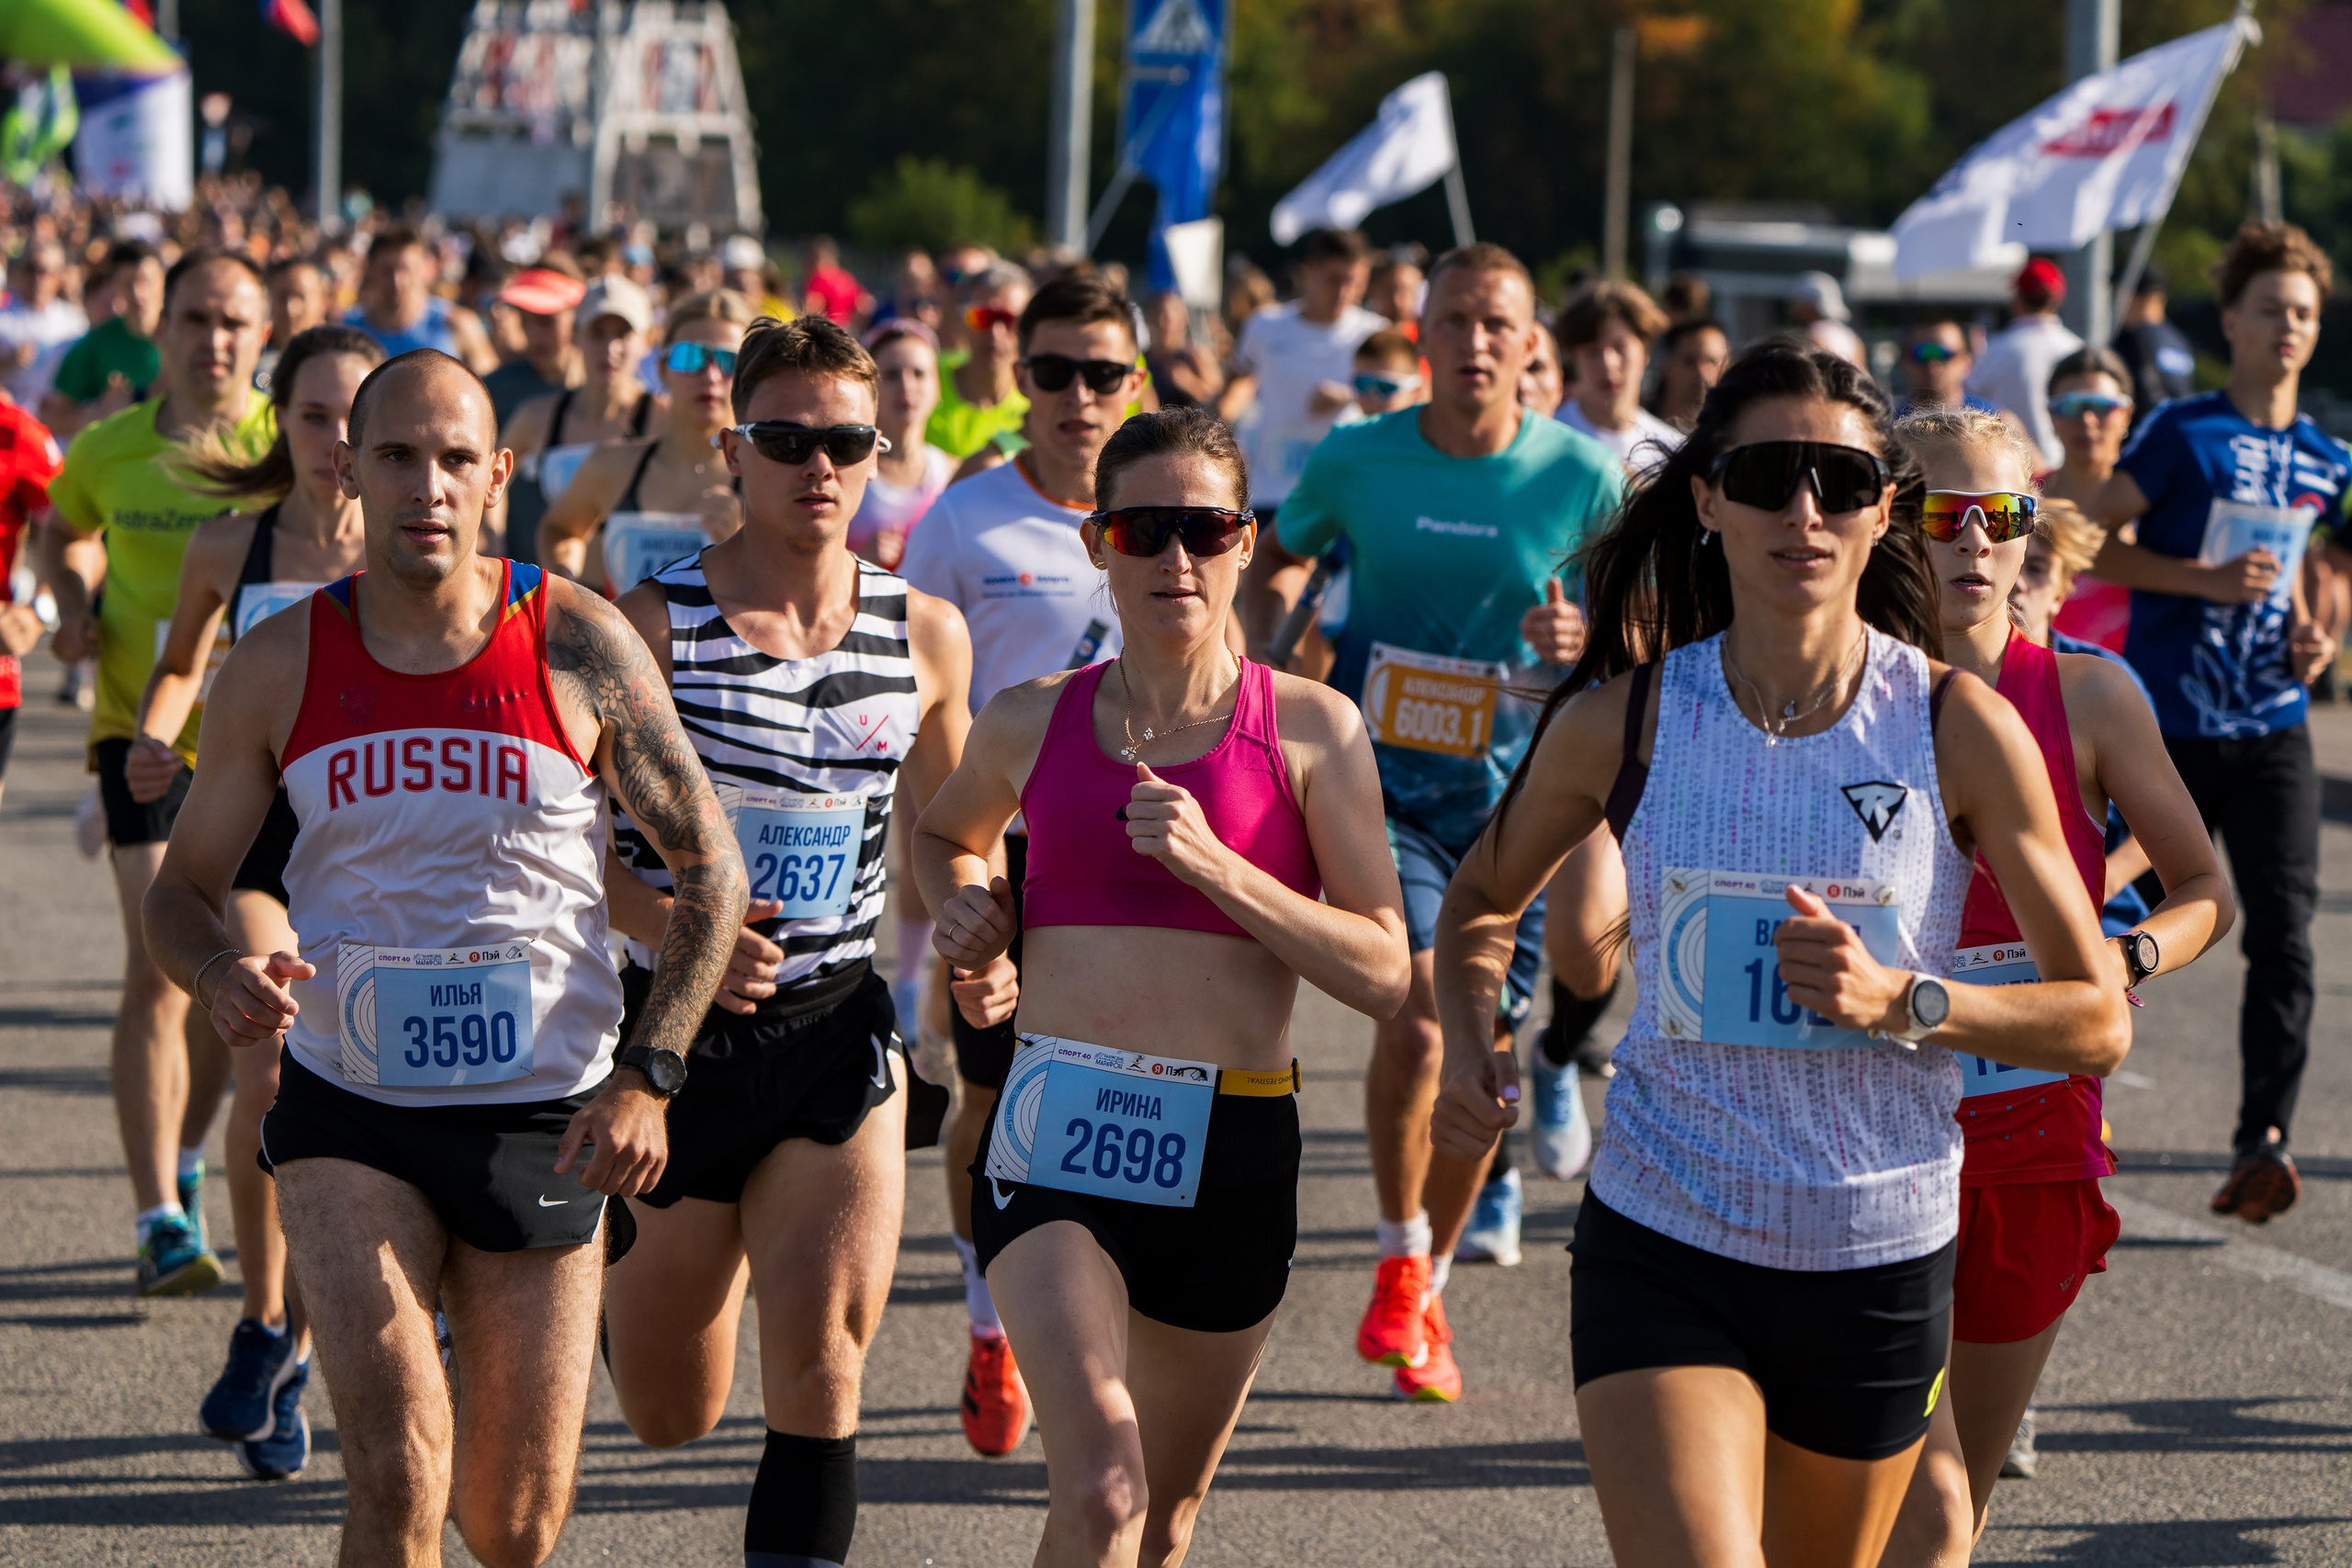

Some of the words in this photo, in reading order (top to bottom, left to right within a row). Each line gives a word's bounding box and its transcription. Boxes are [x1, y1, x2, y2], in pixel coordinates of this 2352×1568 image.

[1416, 516, 1498, 538] Pandora
[859, 715, 867, 726] U
[1395, 698, 1485, 748] 6003.1
[876, 740, 888, 751] M
[327, 736, 529, 812] RUSSIA
[745, 795, 768, 804] СПОРТ
[758, 824, 851, 847] АЛЕКСАНДР
[751, 852, 846, 902] 2637
[1714, 879, 1744, 889] СПОРТ
[1745, 881, 1756, 890] 40
[1843, 885, 1865, 898] Пэй
[378, 954, 401, 963] СПОРТ
[481, 950, 501, 961] Пэй
[2007, 948, 2026, 959] Пэй
[430, 982, 483, 1008] ИЛЬЯ
[402, 1010, 517, 1068] 3590
[1057, 1048, 1082, 1059] СПОРТ
[1081, 1052, 1091, 1060] 40
[1165, 1066, 1184, 1077] Пэй
[1247, 1077, 1277, 1085] FESTIVAL
[1095, 1088, 1162, 1121] ИРИНА
[1060, 1117, 1187, 1189] 2698
